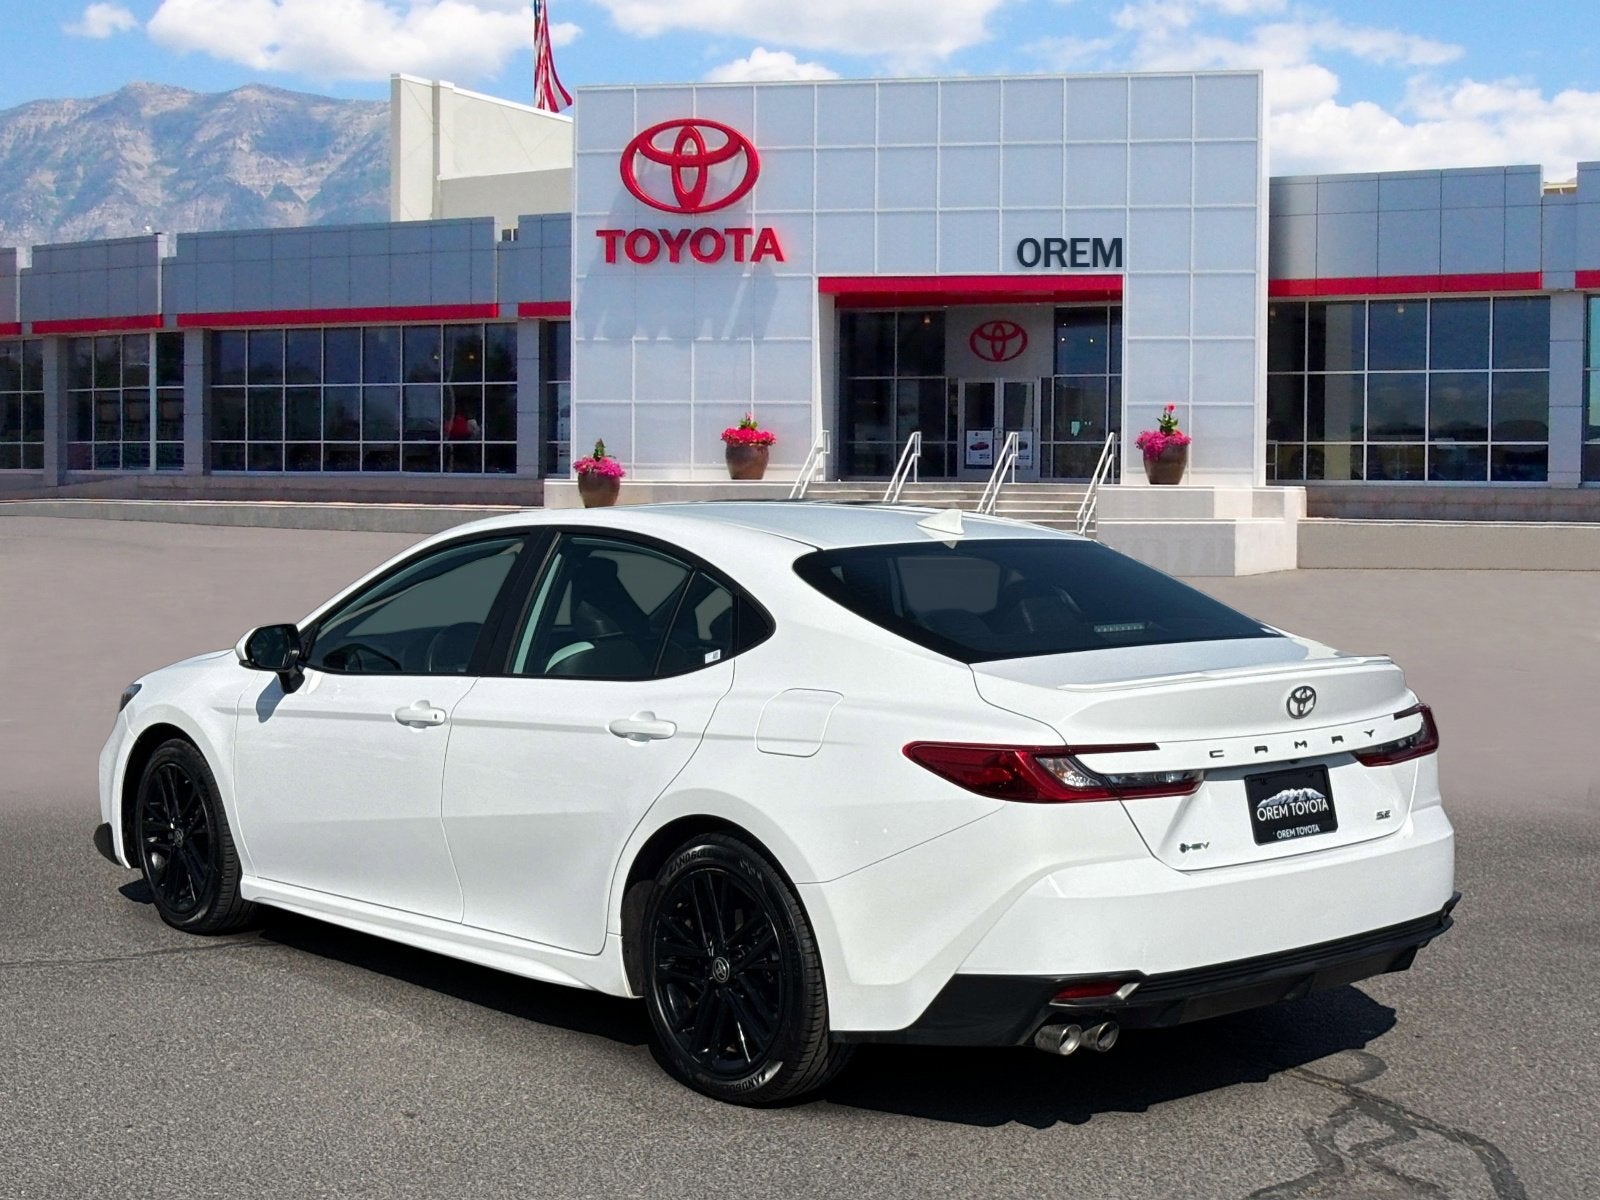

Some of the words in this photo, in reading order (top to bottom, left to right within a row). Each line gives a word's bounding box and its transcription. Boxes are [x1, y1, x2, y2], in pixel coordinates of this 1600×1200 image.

[596, 227, 785, 264] TOYOTA
[1016, 237, 1123, 268] OREM
[1208, 729, 1375, 759] CAMRY
[1256, 804, 1289, 822] OREM
[1290, 800, 1330, 816] TOYOTA
[1375, 809, 1392, 821] SE
[1276, 827, 1296, 840] OREM
[1296, 824, 1321, 836] TOYOTA
